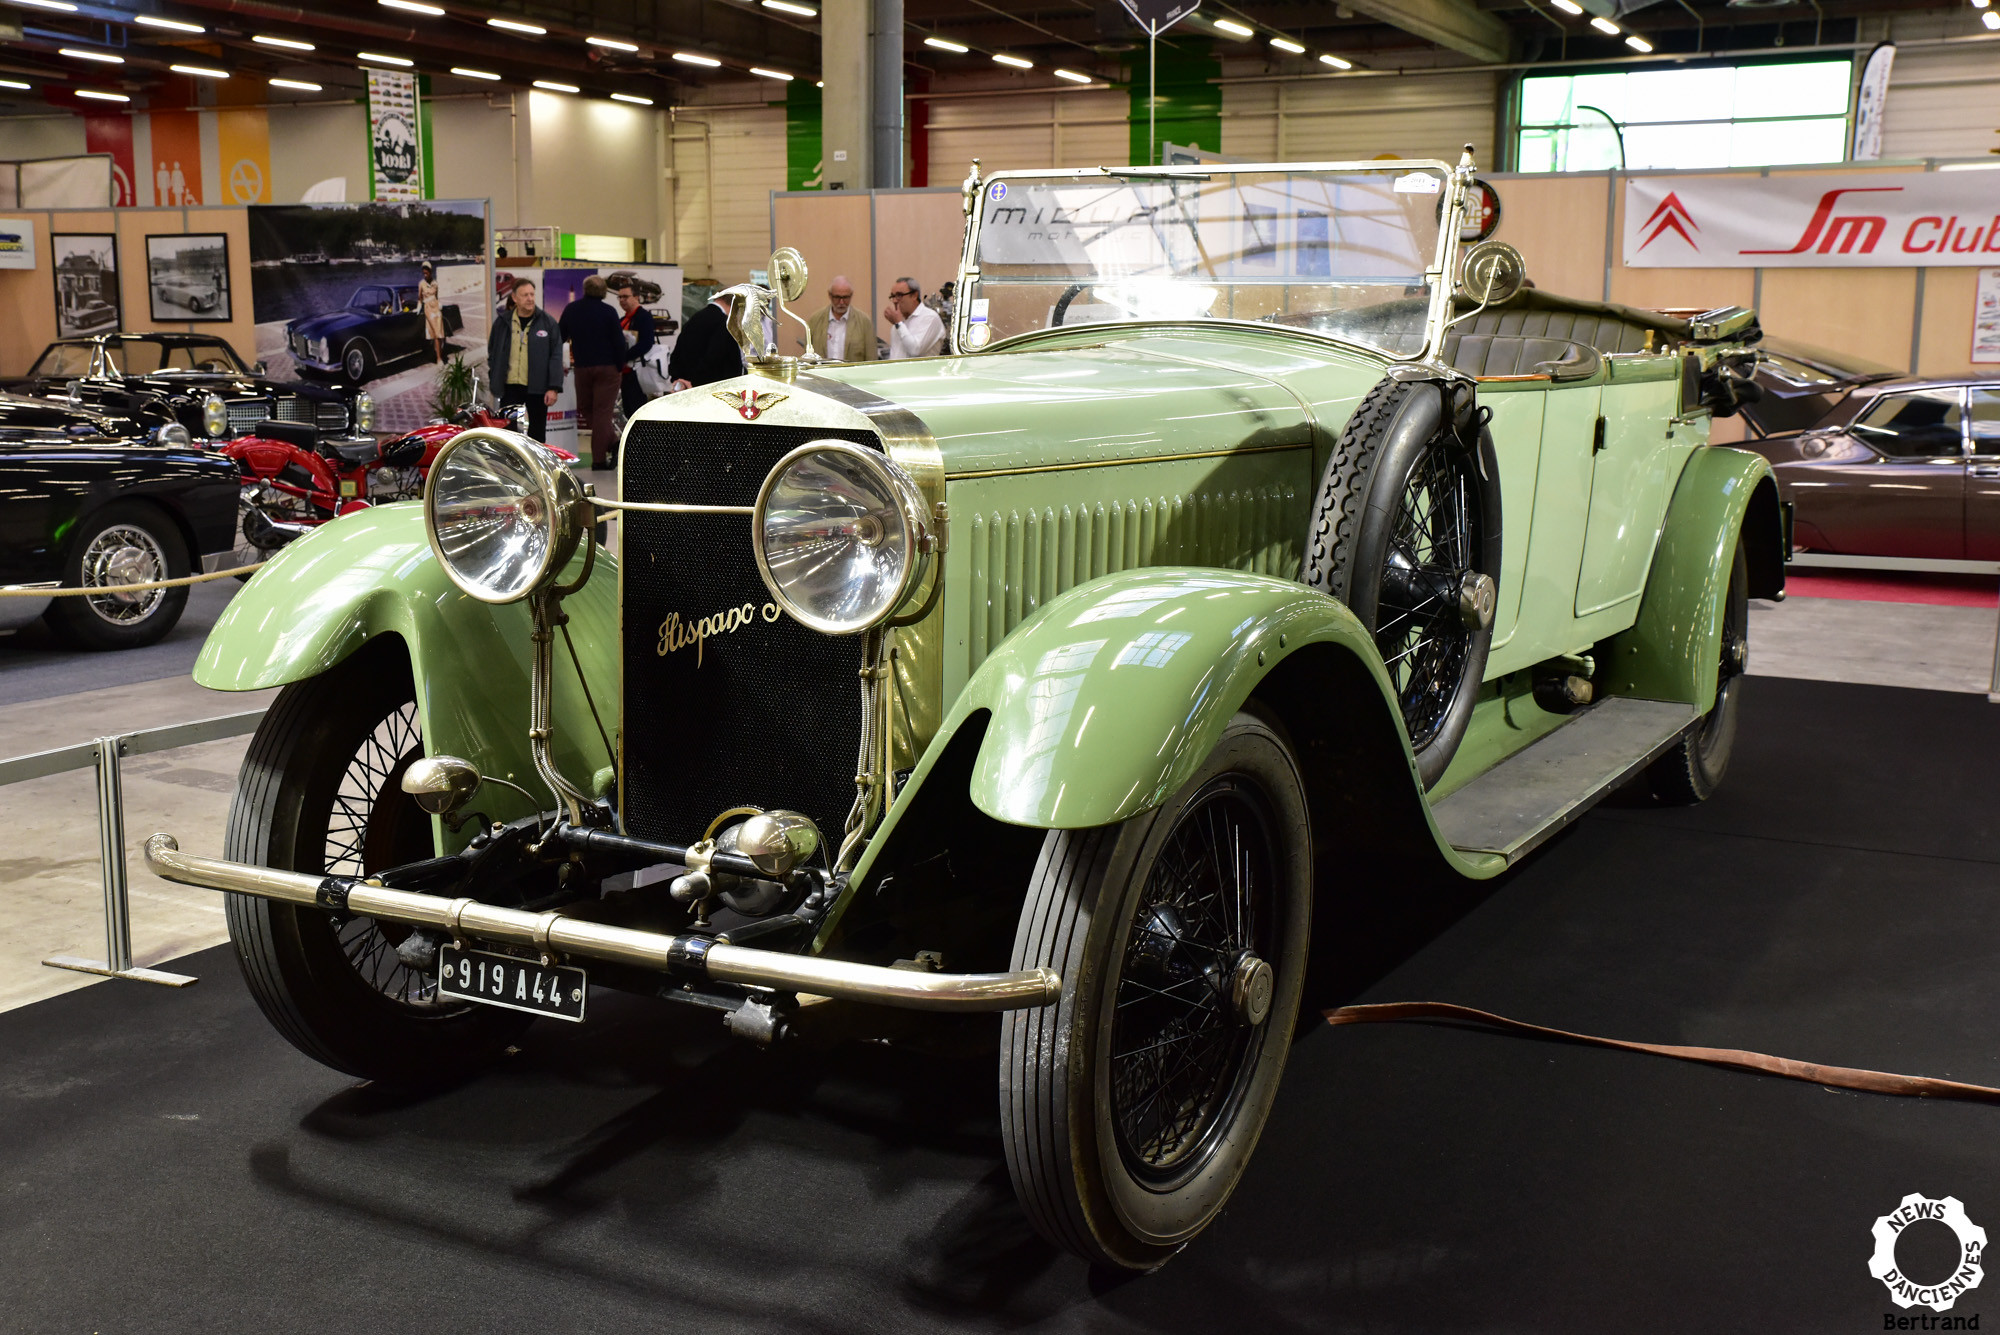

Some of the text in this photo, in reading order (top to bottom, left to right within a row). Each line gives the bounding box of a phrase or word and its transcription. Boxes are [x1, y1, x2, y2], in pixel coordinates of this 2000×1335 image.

[657, 603, 756, 669] Hispano
[459, 958, 562, 1007] 919 A44
